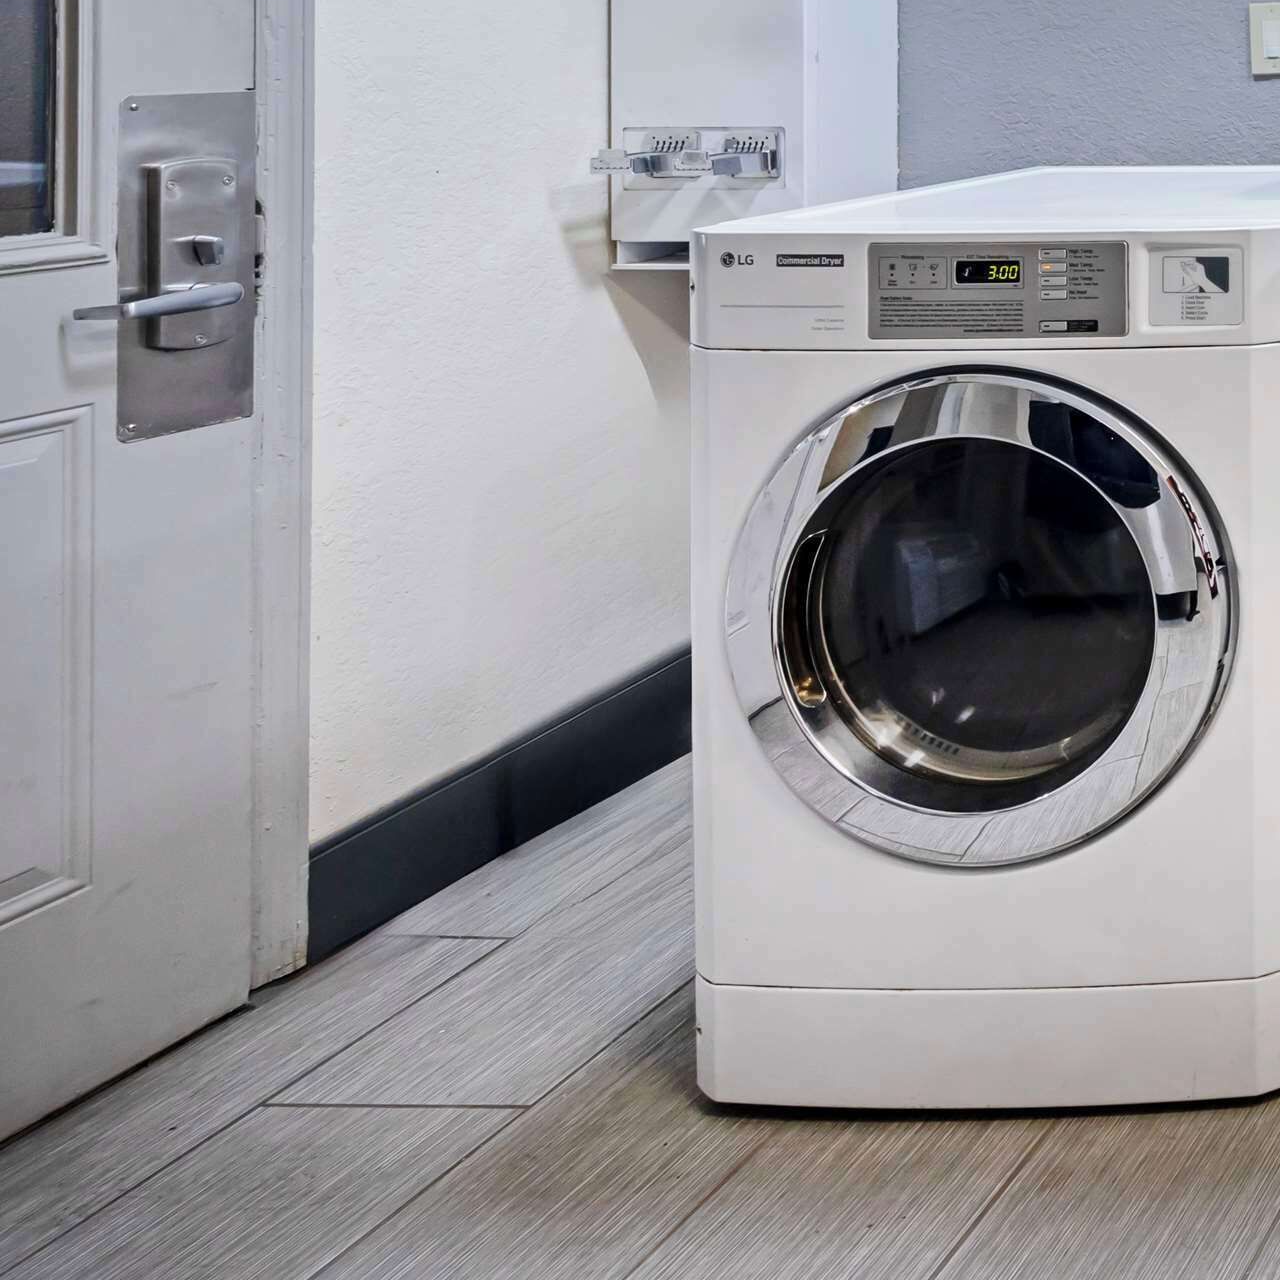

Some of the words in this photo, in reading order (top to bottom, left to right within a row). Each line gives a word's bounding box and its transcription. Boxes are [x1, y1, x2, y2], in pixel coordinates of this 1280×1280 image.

[737, 254, 754, 265] LG
[777, 256, 820, 265] Commercial
[821, 256, 842, 267] Dryer
